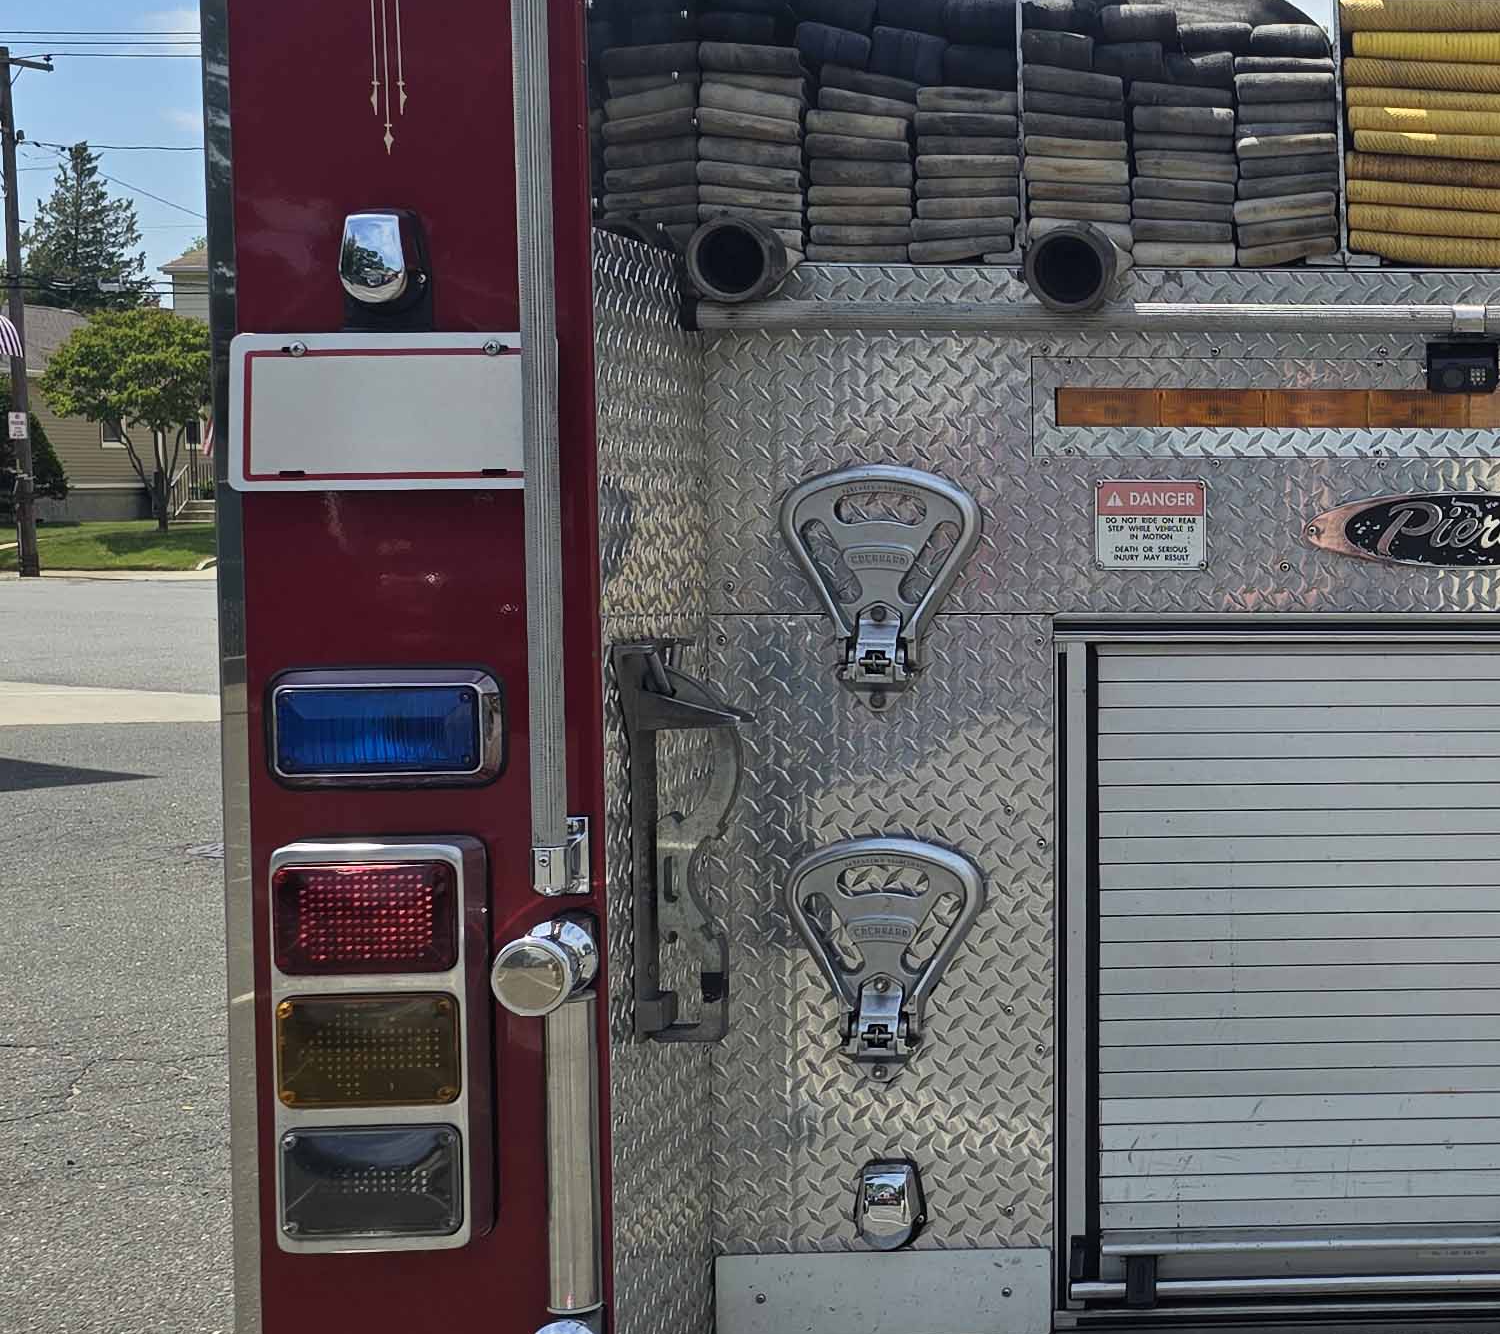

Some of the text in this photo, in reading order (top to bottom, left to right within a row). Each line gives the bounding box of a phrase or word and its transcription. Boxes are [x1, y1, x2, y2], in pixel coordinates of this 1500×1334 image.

[1129, 492, 1195, 507] DANGER
[1113, 554, 1191, 562] INJURY MAY RESULT
